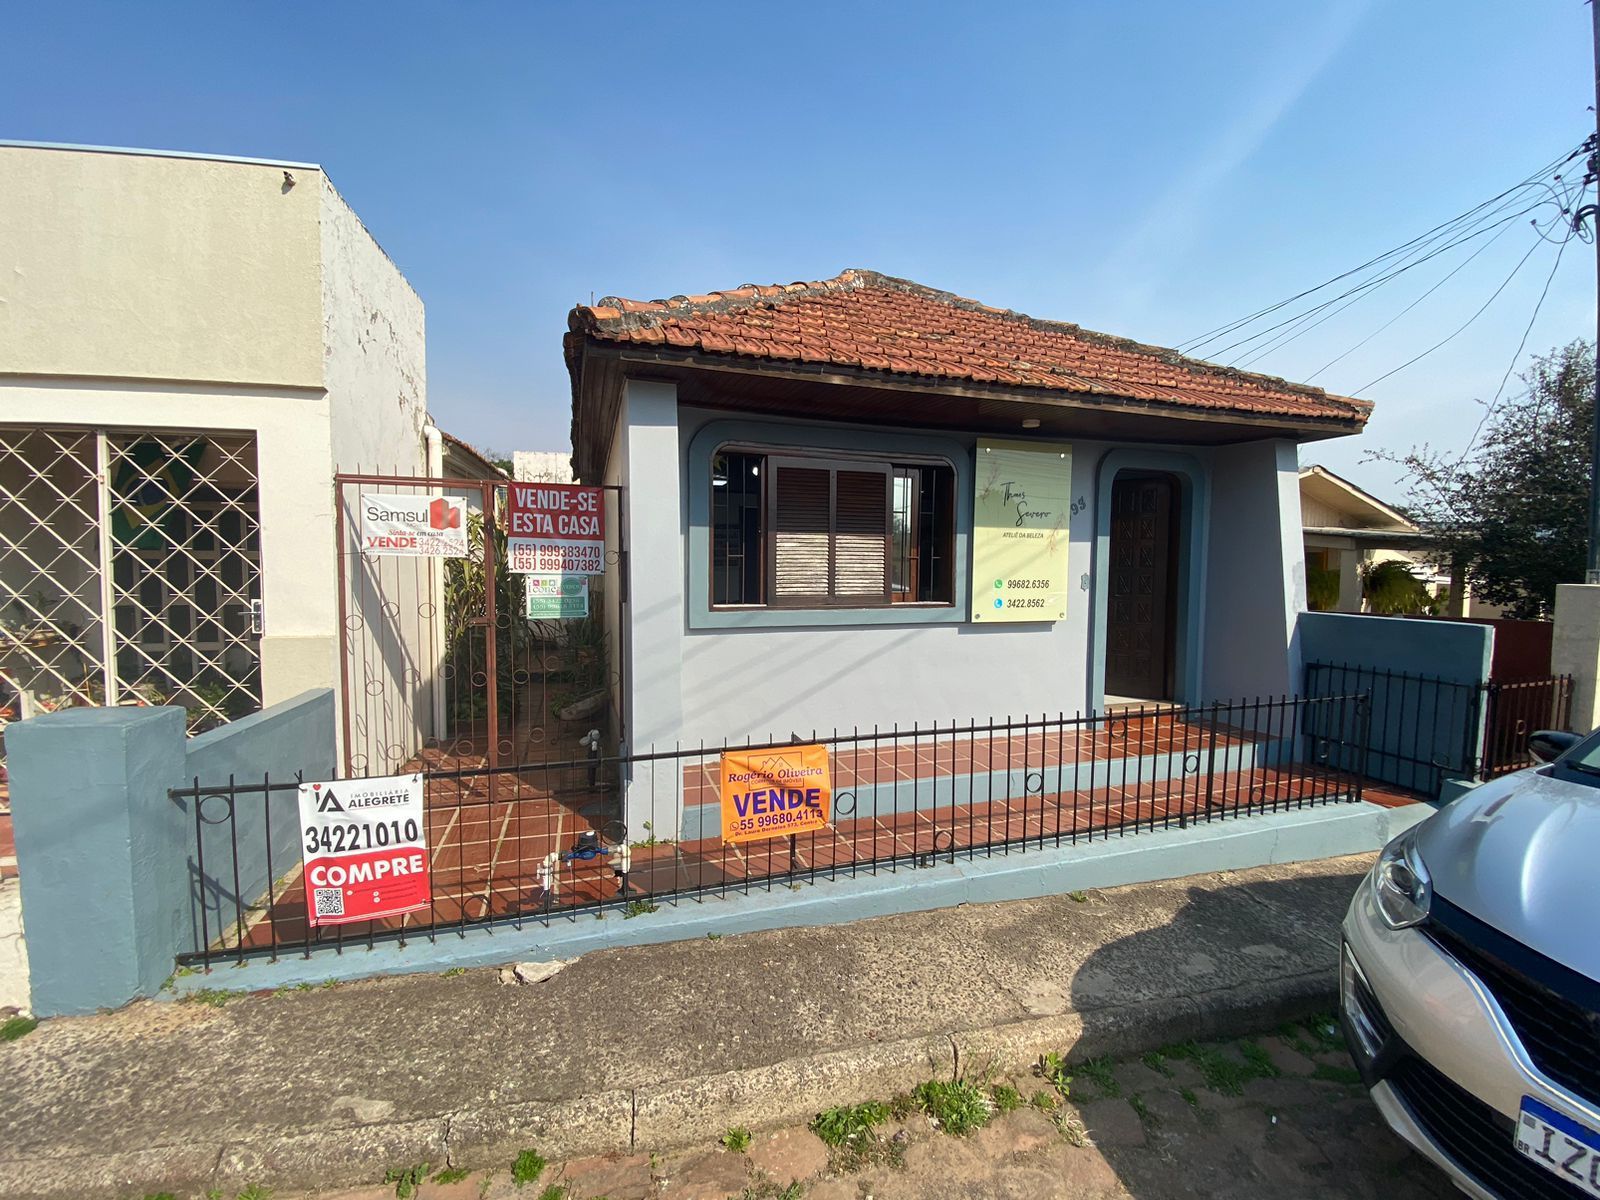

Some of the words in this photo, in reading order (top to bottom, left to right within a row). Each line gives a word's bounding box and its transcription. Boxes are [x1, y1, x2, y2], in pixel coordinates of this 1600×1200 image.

[515, 488, 597, 512] VENDE-SE
[367, 506, 428, 523] Samsul
[513, 512, 554, 533] ESTA
[558, 514, 600, 535] CASA
[367, 536, 417, 548] VENDE
[513, 543, 536, 556] (55)
[540, 544, 600, 558] 999383470
[513, 556, 536, 570] (55)
[540, 558, 600, 571] 999407382
[1007, 579, 1050, 589] 99682.6356
[1006, 598, 1045, 608] 3422.8562
[777, 766, 823, 779] Oliveira
[348, 793, 410, 809] ALEGRETE
[732, 788, 820, 818] VENDE
[740, 818, 754, 831] 55
[757, 808, 823, 828] 99680.4113
[305, 818, 418, 854] 34221010
[310, 854, 424, 887] COMPRE
[1517, 1140, 1530, 1155] BR
